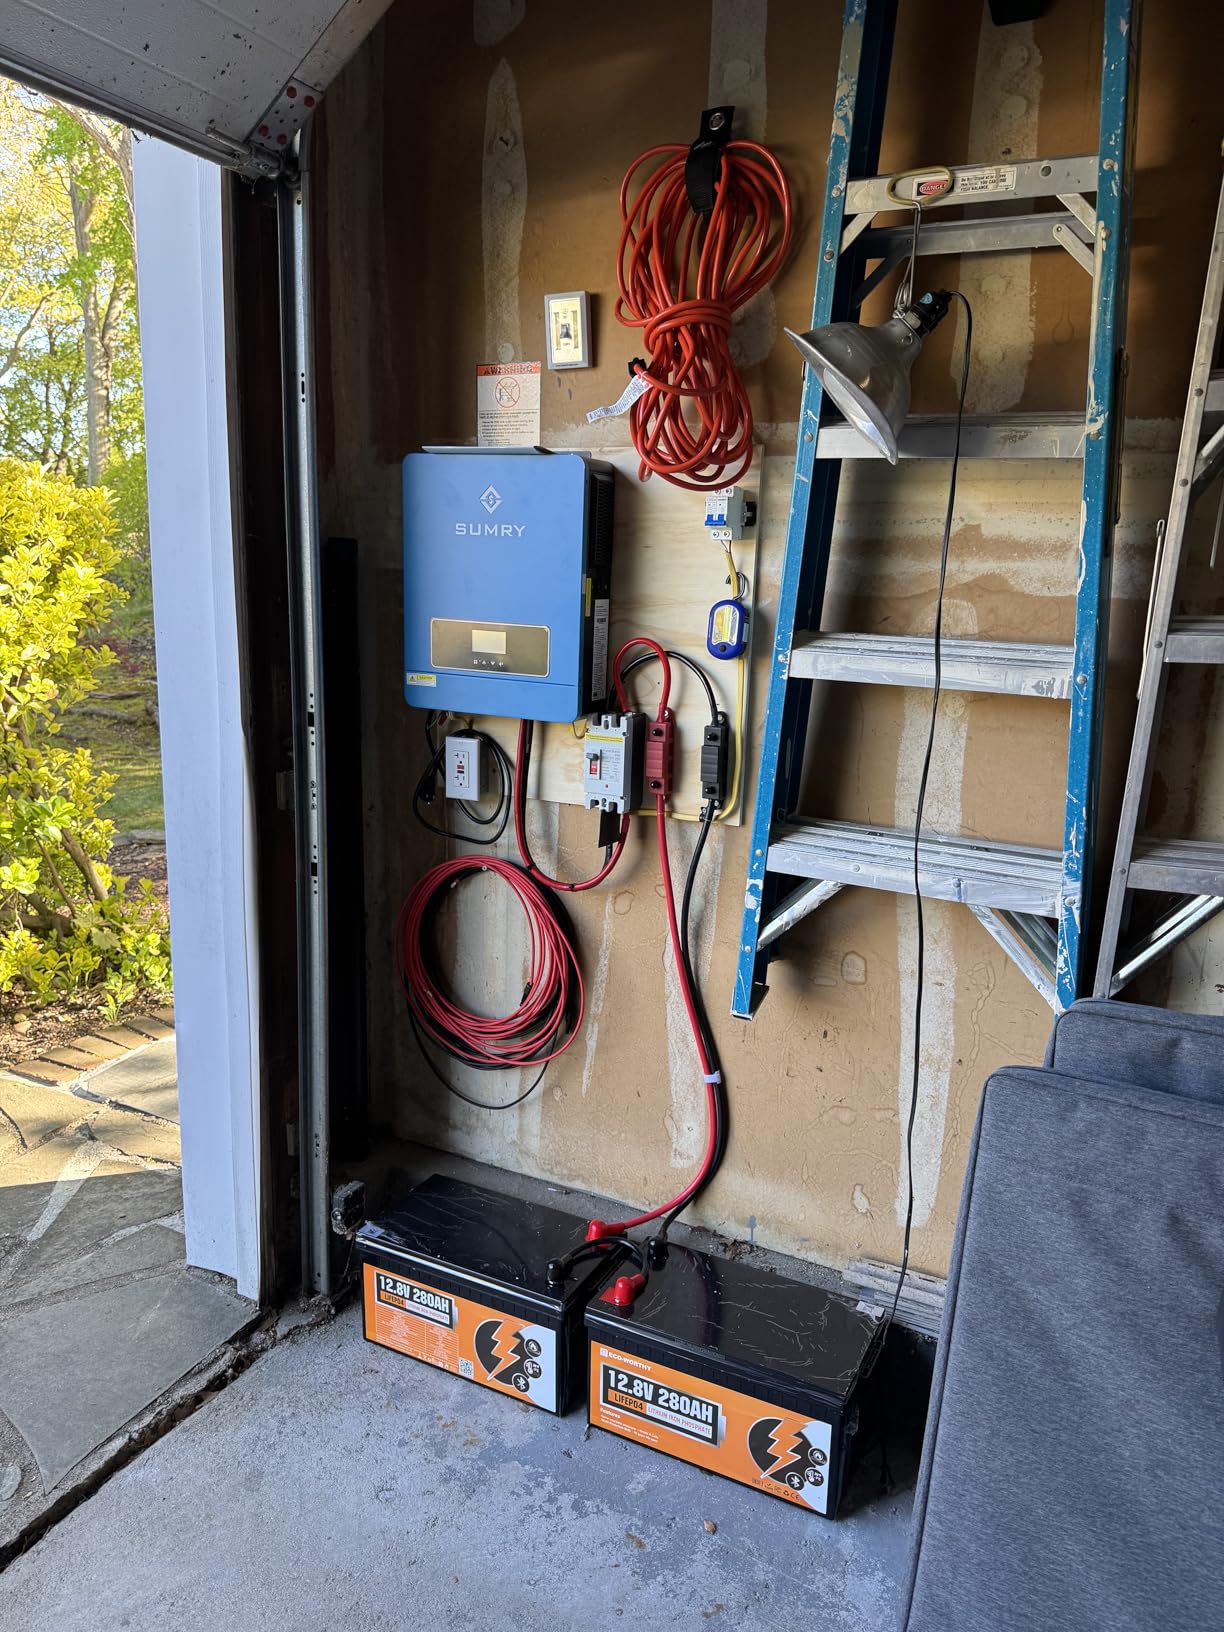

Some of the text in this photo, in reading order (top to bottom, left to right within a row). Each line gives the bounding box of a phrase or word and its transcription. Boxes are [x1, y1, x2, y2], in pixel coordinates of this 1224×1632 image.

[455, 523, 526, 537] SUMRY
[379, 1275, 449, 1313] 12.8V 280AH
[608, 1353, 652, 1371] ECO-WORTHY
[608, 1369, 713, 1424] 12.8V 280AH
[681, 1416, 712, 1435] PHOSPHATE
